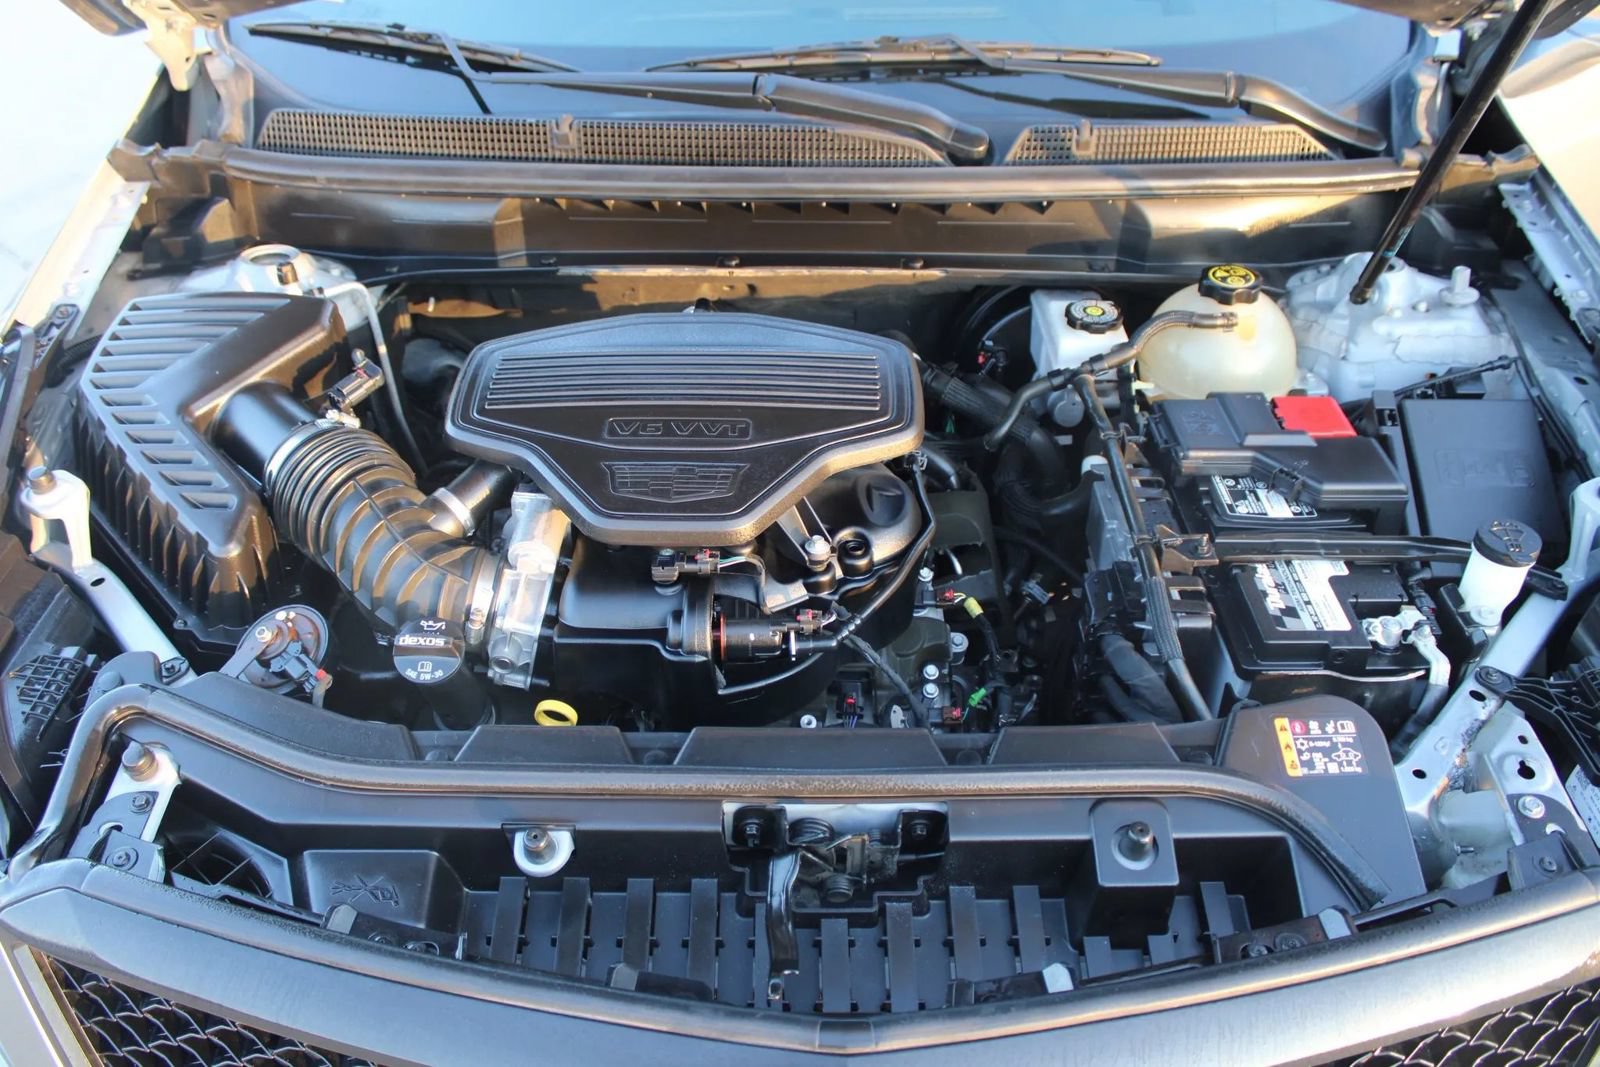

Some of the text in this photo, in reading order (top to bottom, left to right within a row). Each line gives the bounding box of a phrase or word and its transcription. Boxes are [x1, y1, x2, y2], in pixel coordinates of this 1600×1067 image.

[612, 421, 747, 436] V6 VVT
[399, 635, 446, 646] dexos
[405, 669, 443, 681] SAE 5W-30
